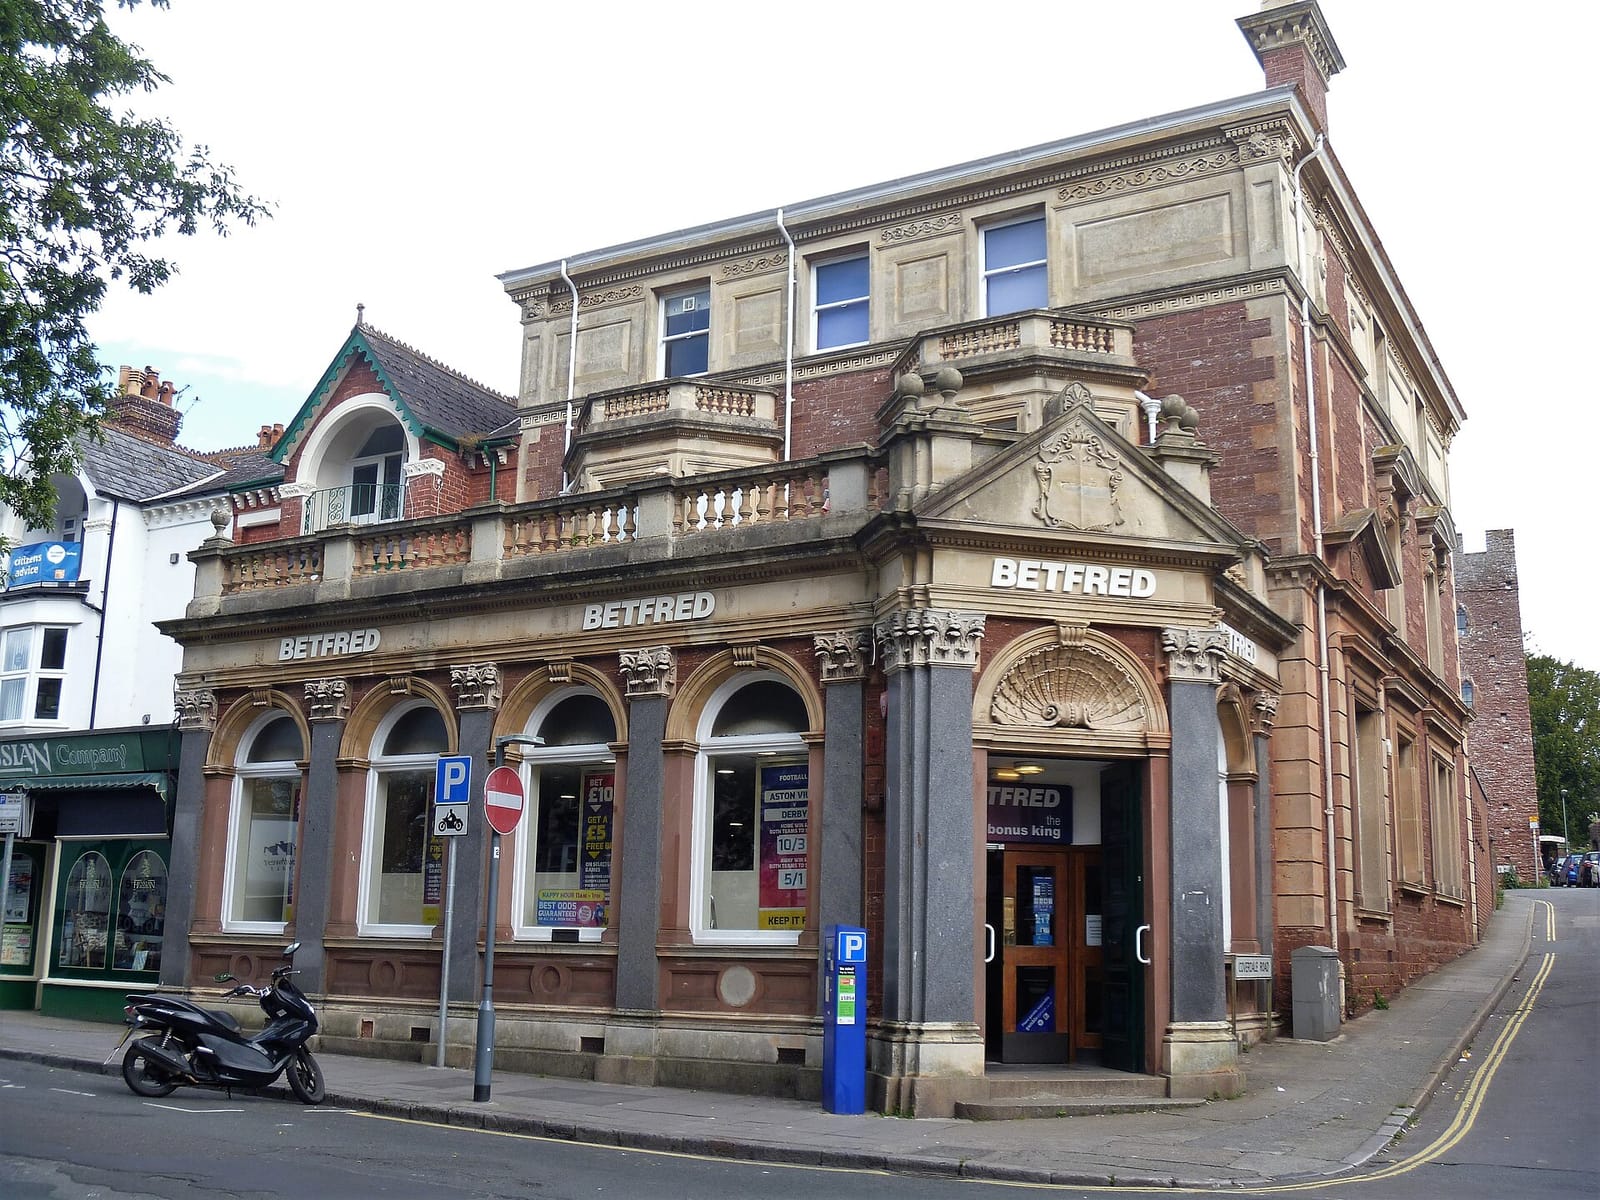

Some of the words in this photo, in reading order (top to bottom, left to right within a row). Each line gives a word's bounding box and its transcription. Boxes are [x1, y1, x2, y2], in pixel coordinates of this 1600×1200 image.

[14, 554, 42, 566] citizens
[14, 566, 39, 578] advice
[990, 557, 1157, 599] BETFRED
[583, 591, 716, 631] BETFRED
[279, 628, 381, 661] BETFRED
[56, 744, 127, 769] Company
[443, 762, 466, 800] P
[779, 774, 808, 782] FOOTBALL
[588, 787, 613, 802] £10
[770, 792, 796, 801] ASTON
[987, 786, 1061, 808] TFRED
[603, 815, 608, 823] A
[782, 810, 808, 818] DERBY
[1046, 815, 1061, 826] the
[586, 825, 606, 841] £5
[988, 824, 1028, 836] bonus
[1032, 825, 1061, 839] king
[585, 842, 604, 850] FREE
[778, 839, 805, 851] 10/3
[784, 873, 803, 886] 5/1
[768, 917, 789, 925] KEEP
[846, 936, 863, 960] P
